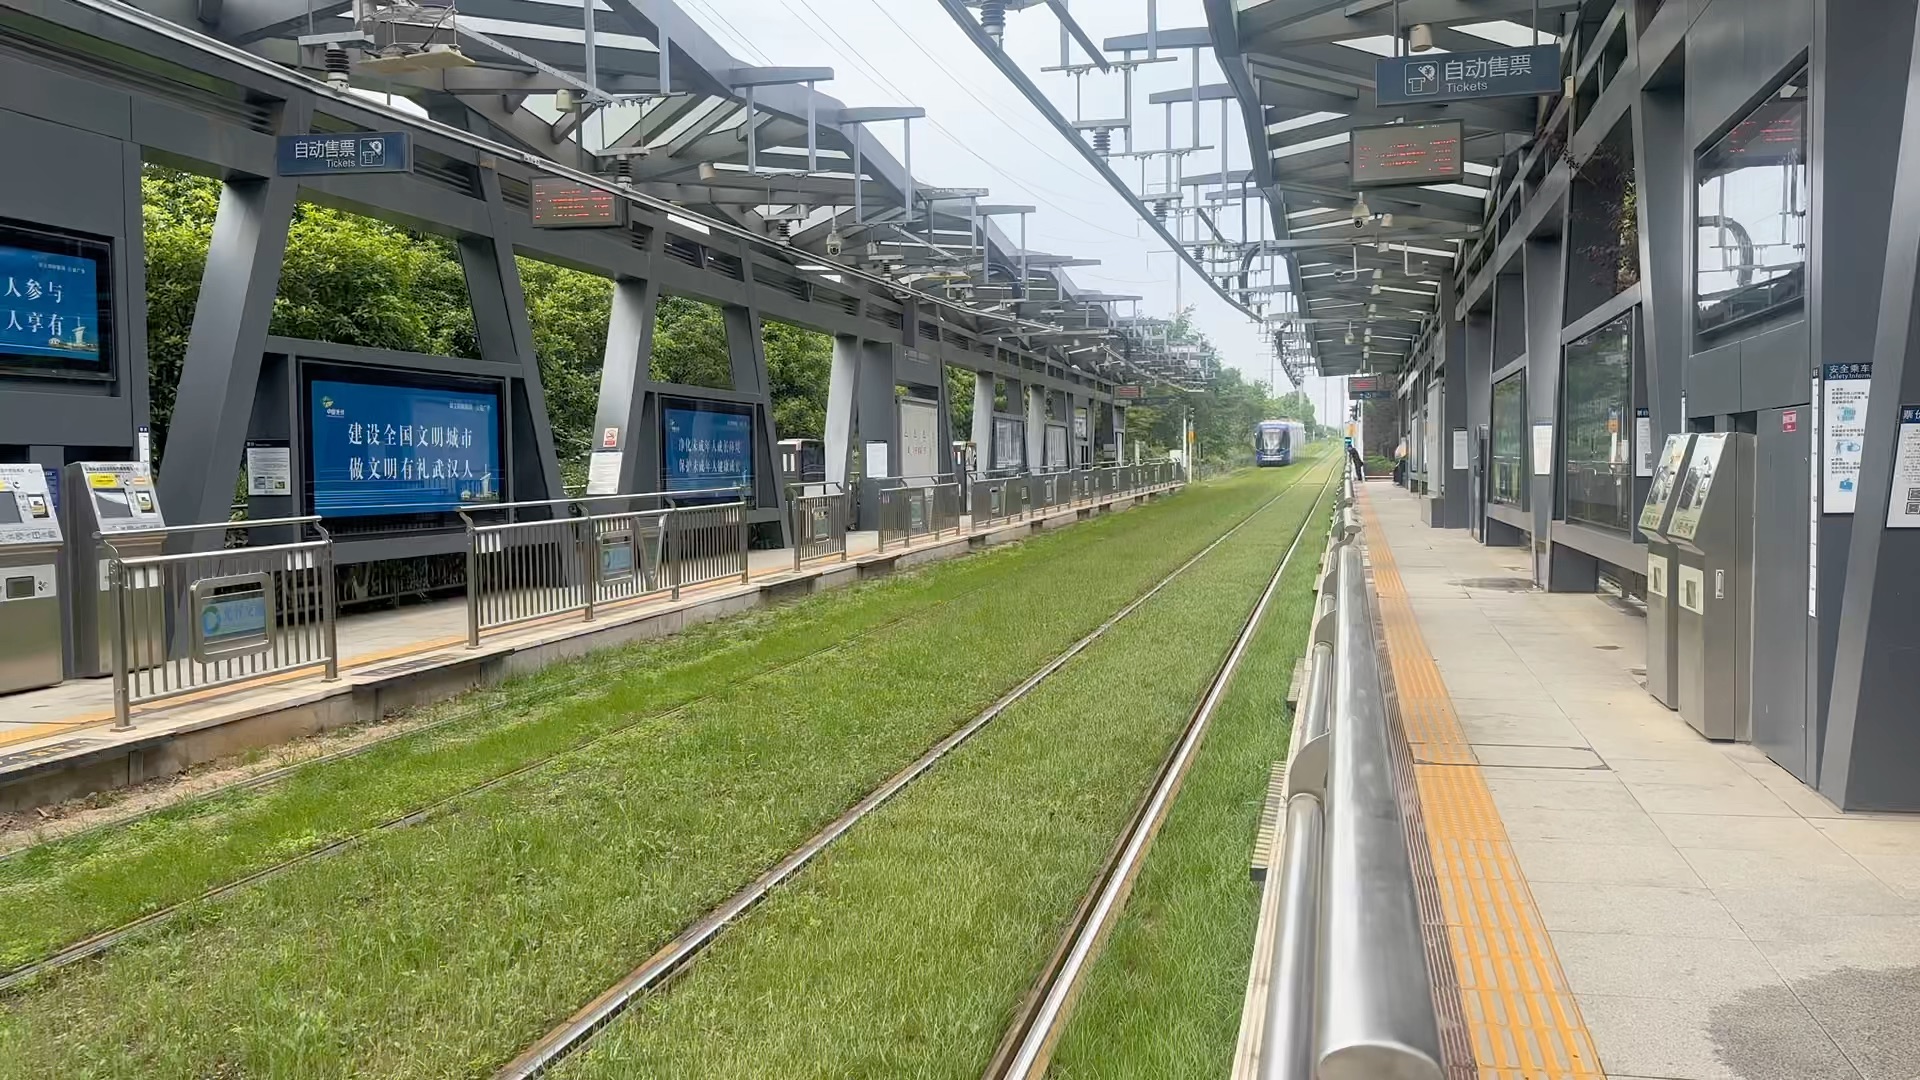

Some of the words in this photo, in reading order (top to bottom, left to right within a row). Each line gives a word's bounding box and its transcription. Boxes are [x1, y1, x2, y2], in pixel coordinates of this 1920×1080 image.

[1445, 54, 1532, 80] 自动售票
[1447, 82, 1488, 93] Tickets
[295, 140, 355, 159] 自动售票
[326, 159, 356, 168] Tickets
[4, 276, 63, 303] 人参与
[6, 310, 64, 336] 人享有
[1829, 364, 1873, 374] 安全乘车
[348, 422, 473, 448] 建设全国文明城市
[350, 457, 473, 481] 做文明有礼武汉人
